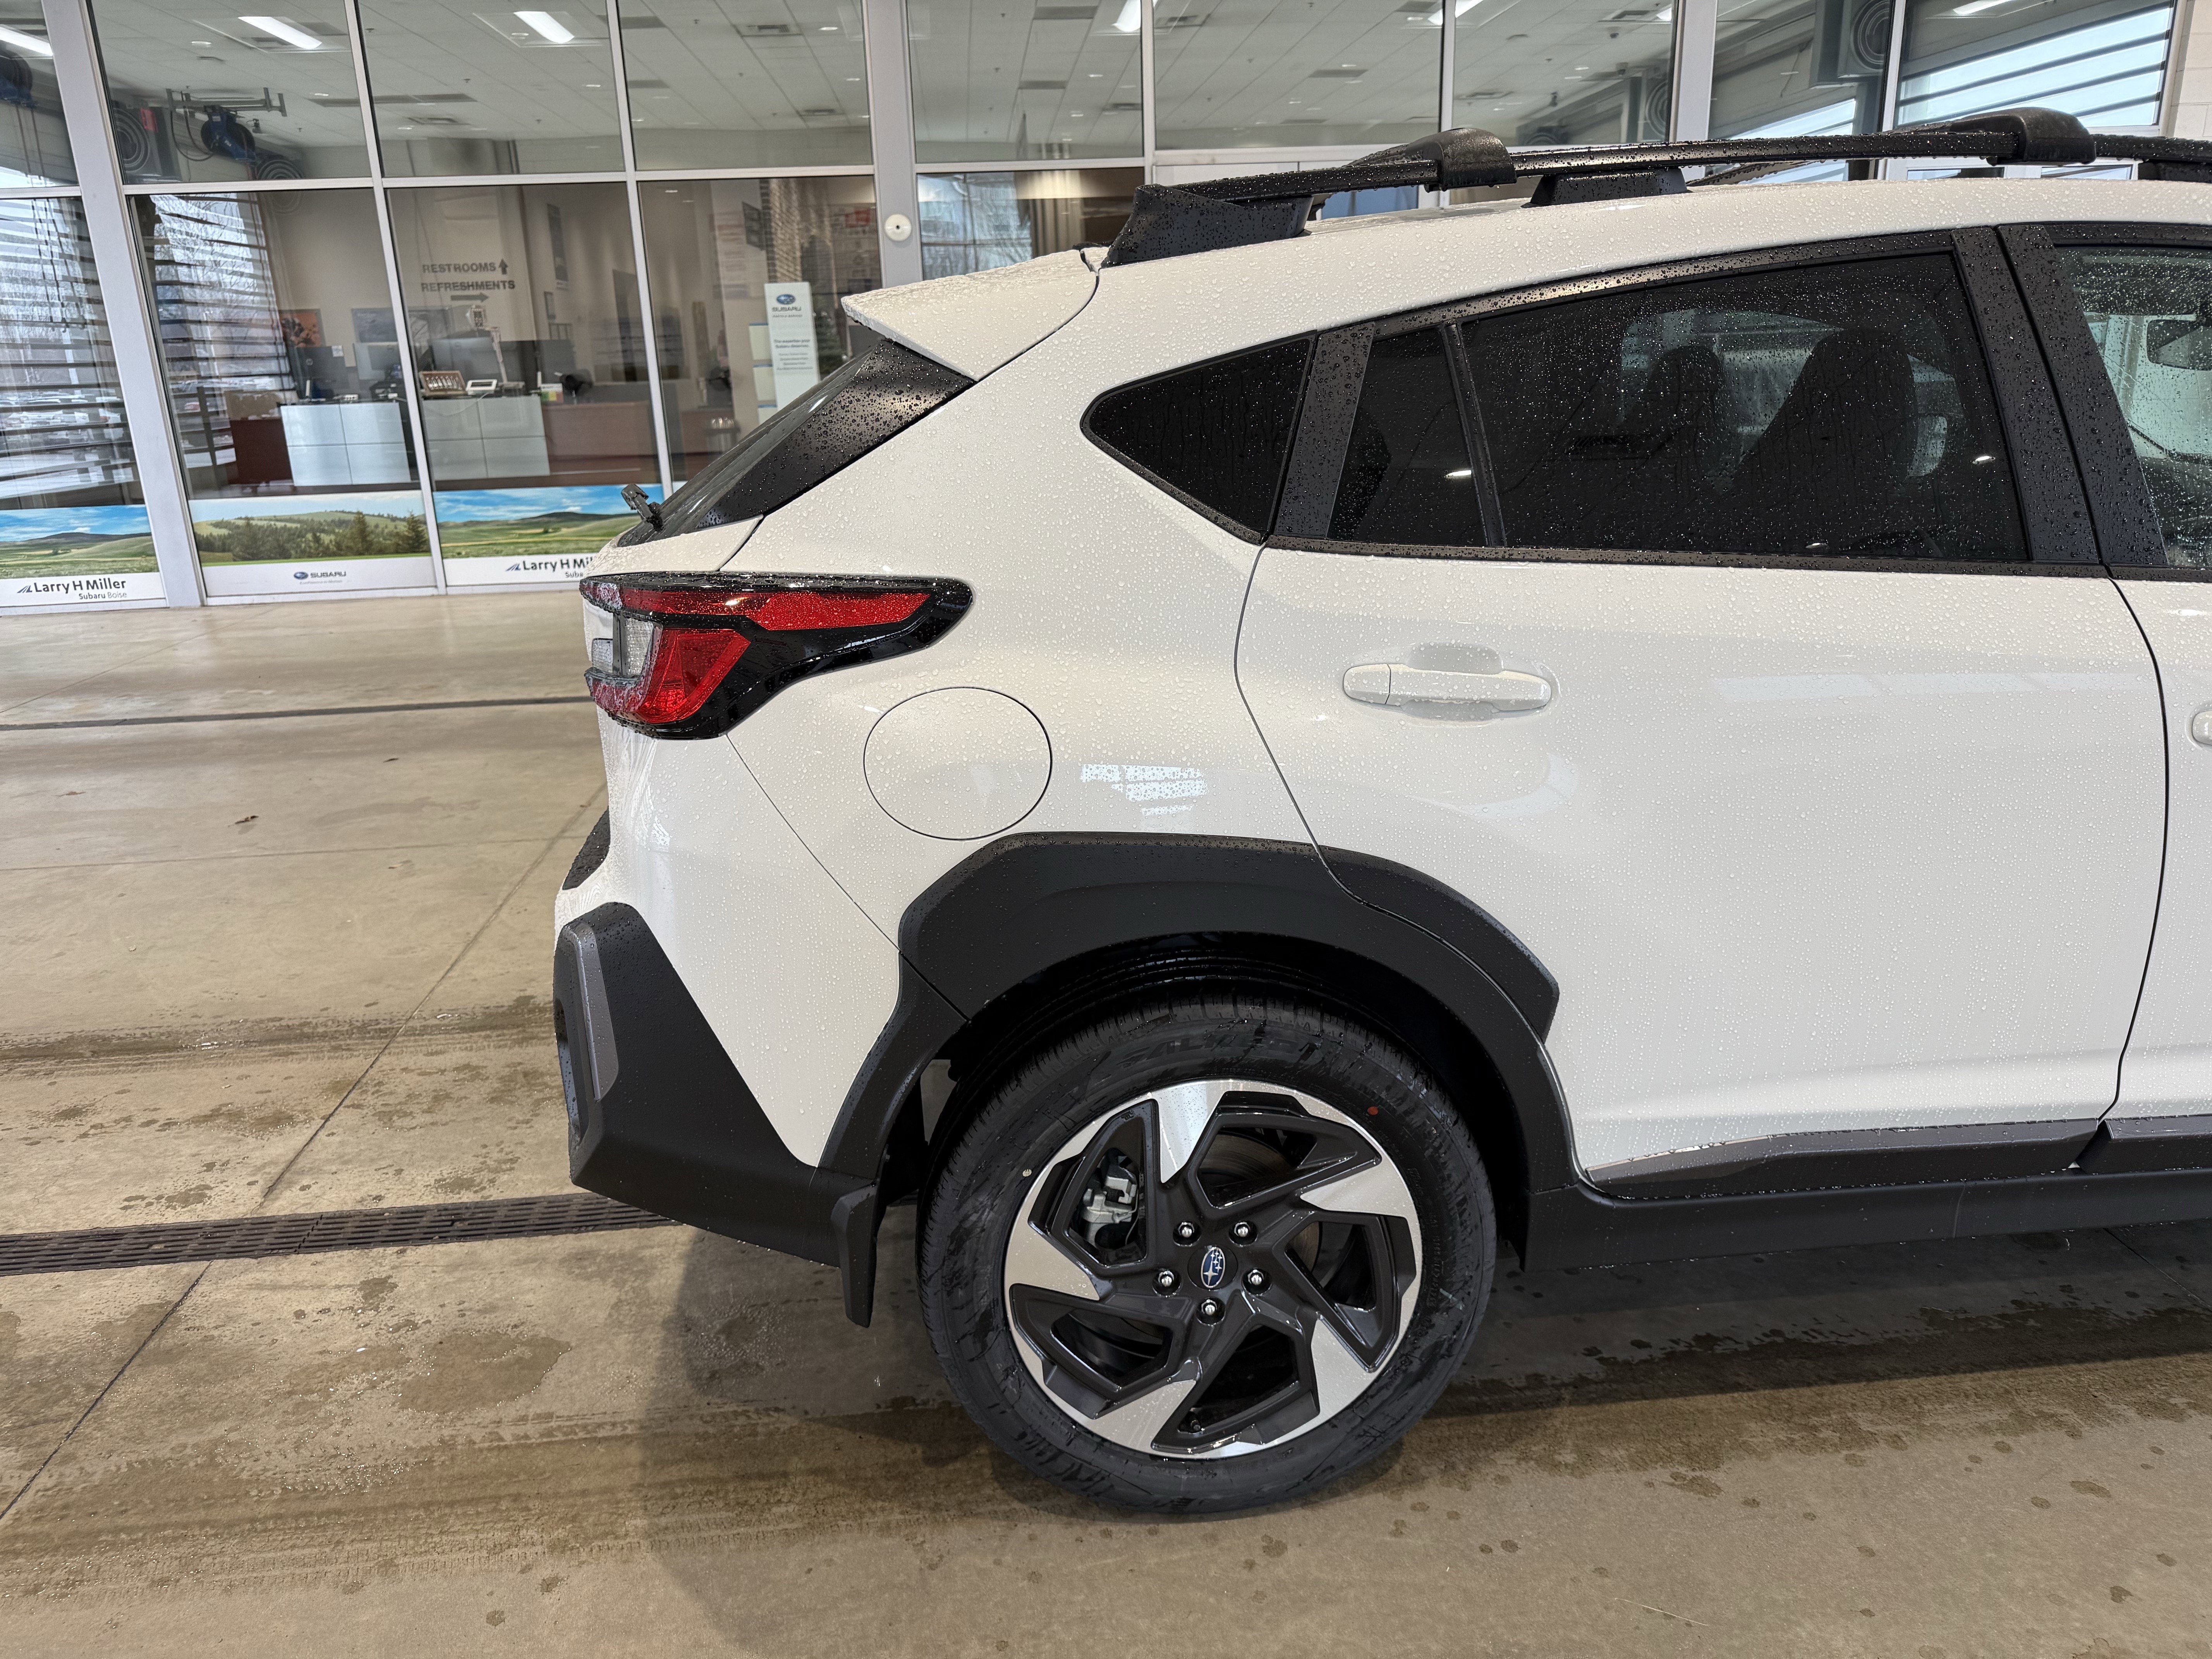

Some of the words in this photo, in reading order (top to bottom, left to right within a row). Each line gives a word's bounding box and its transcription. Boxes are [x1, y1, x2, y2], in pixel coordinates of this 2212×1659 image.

[422, 262, 496, 273] RESTROOMS
[421, 280, 515, 292] REFRESHMENTS
[523, 560, 558, 573] Larry
[560, 559, 570, 569] H
[34, 582, 70, 594] Larry
[72, 580, 84, 591] H
[86, 577, 126, 590] Miller
